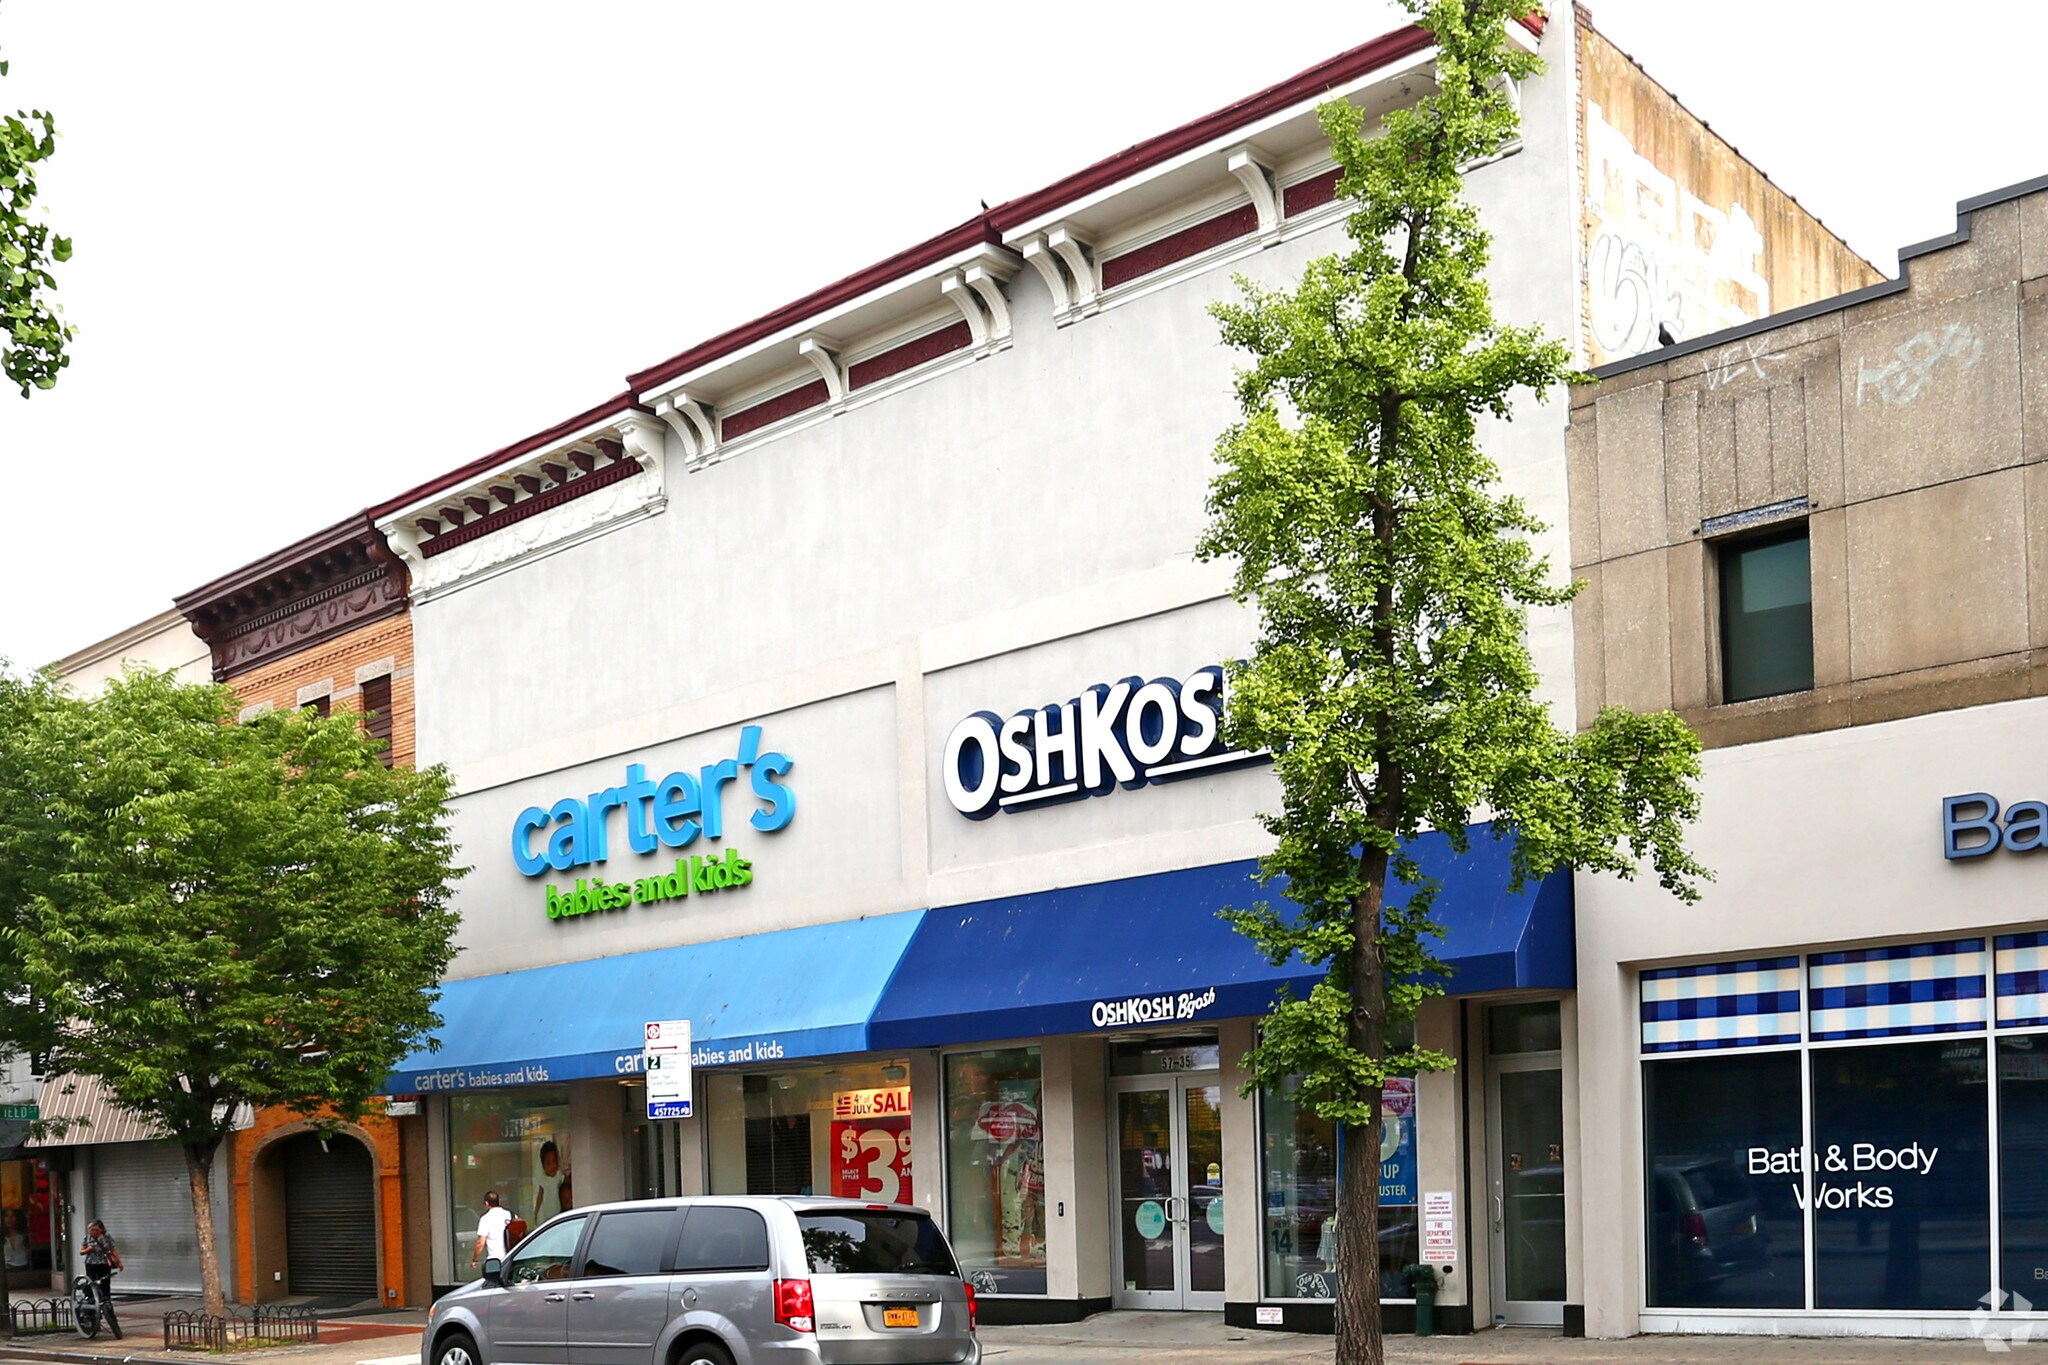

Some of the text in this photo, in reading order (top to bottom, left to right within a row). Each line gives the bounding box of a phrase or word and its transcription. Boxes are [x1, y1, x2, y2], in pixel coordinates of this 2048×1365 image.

[512, 725, 796, 877] carter's
[546, 848, 753, 918] babies and kids
[692, 1047, 725, 1067] abies
[728, 1043, 753, 1063] and
[756, 1040, 784, 1060] kids
[1161, 1055, 1191, 1070] 57-35
[414, 1065, 549, 1091] carter's babies and kids
[852, 1103, 872, 1115] JULY
[1383, 1163, 1399, 1178] UP
[1824, 1144, 1849, 1172] &
[1853, 1141, 1939, 1175] Body
[1379, 1184, 1407, 1196] USTER
[1271, 1228, 1292, 1254] 14
